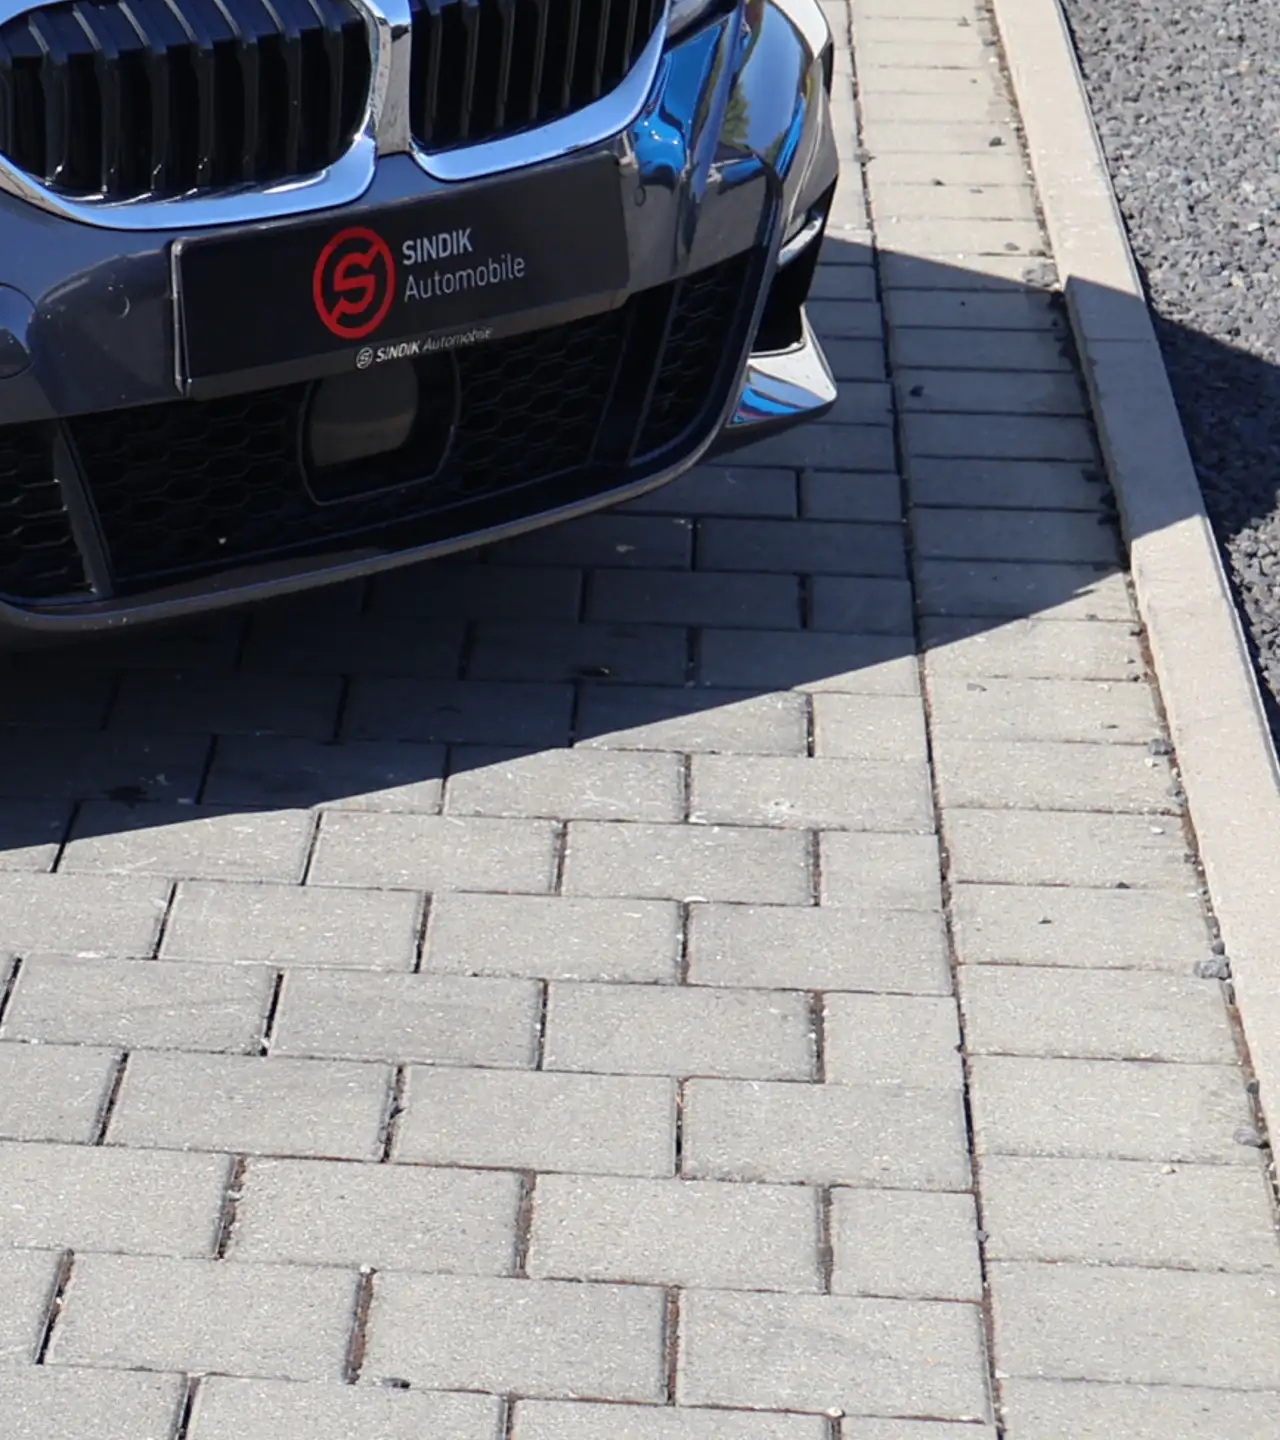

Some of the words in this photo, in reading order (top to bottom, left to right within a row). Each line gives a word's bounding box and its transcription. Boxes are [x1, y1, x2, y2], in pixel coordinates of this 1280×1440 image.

[402, 227, 473, 266] SINDIK
[403, 254, 526, 302] Automobile
[375, 341, 420, 362] SINDIK
